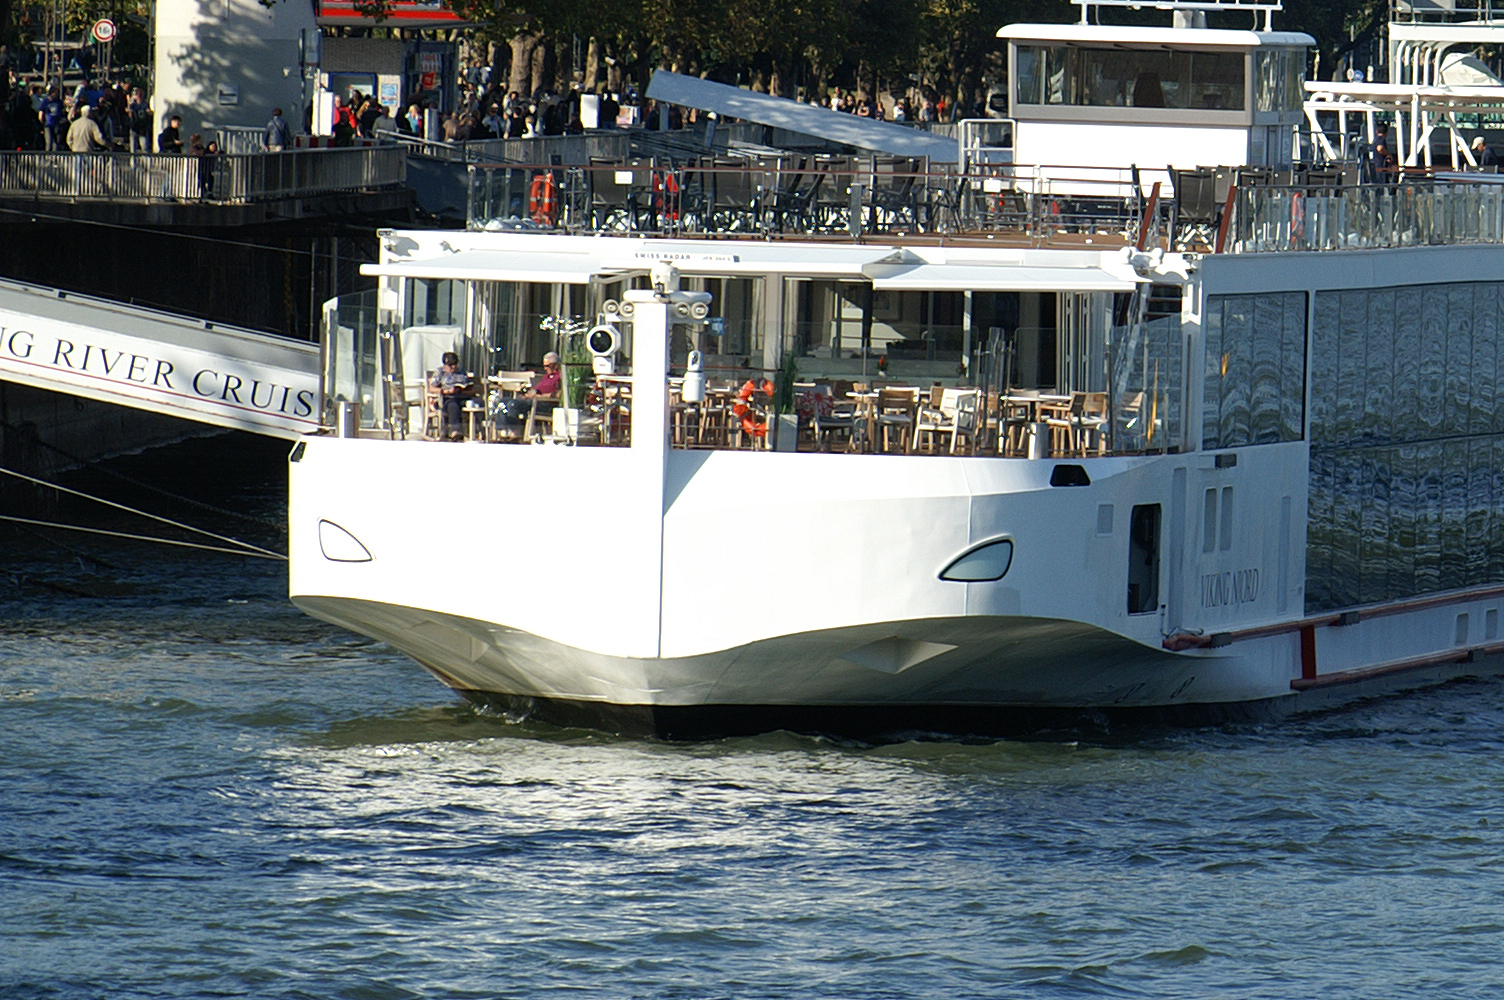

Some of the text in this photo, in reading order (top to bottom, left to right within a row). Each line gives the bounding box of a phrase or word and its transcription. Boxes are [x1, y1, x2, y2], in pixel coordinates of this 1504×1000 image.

[52, 338, 175, 389] RIVER
[192, 368, 315, 418] CRUIS
[1201, 568, 1259, 611] VIKING NJORD
